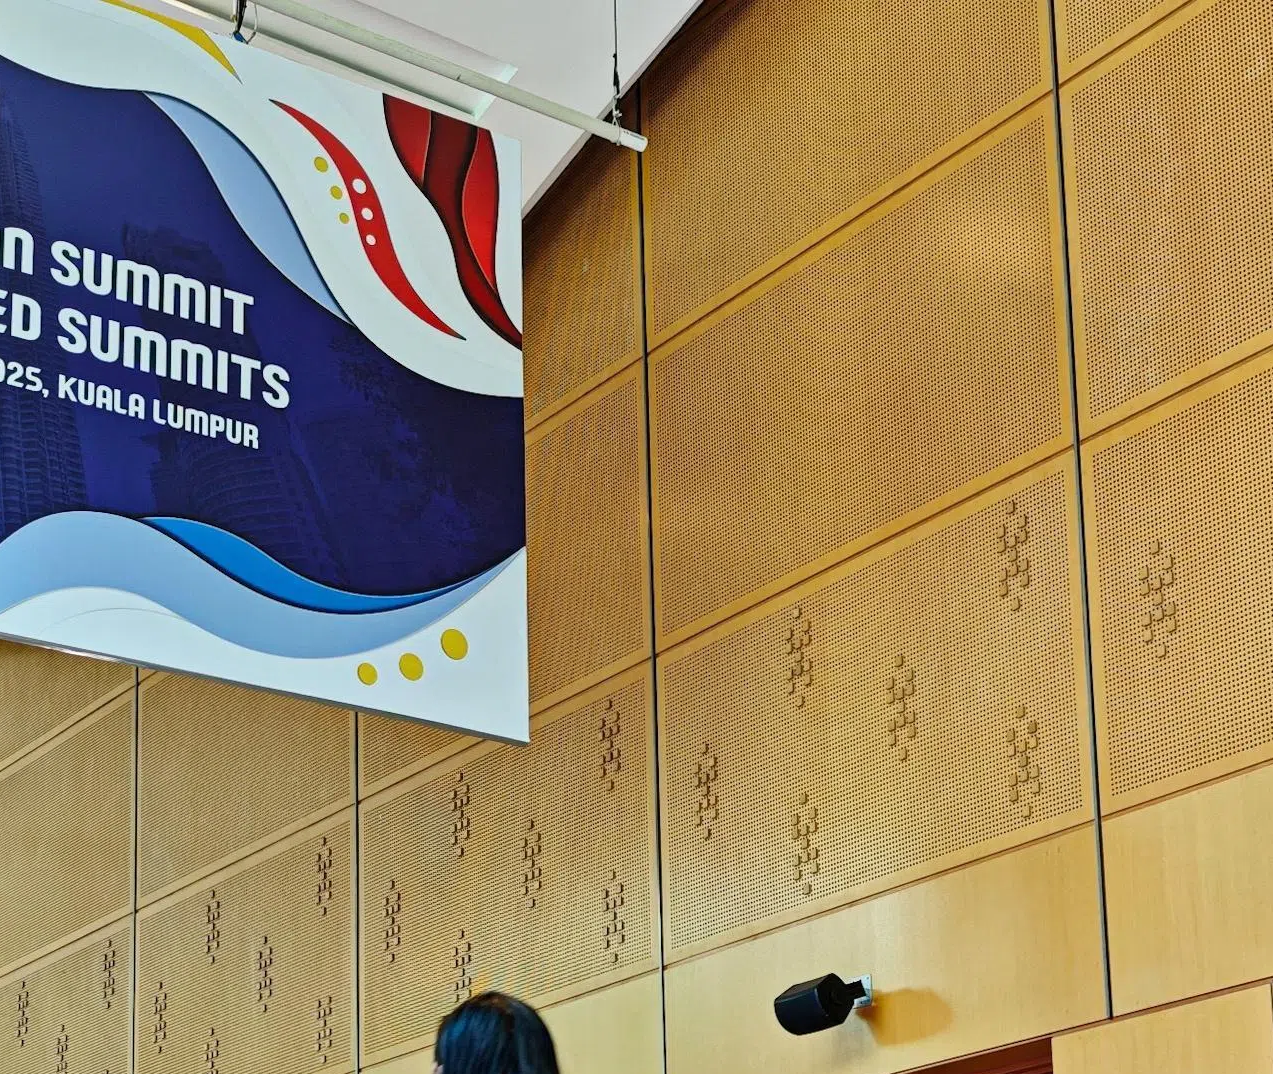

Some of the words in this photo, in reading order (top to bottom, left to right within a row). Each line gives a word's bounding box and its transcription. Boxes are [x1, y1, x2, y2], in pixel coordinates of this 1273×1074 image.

[50, 240, 255, 335] SUMMIT
[57, 307, 291, 409] SUMMITS
[58, 373, 146, 420] KUALA
[153, 398, 260, 450] LUMPUR
